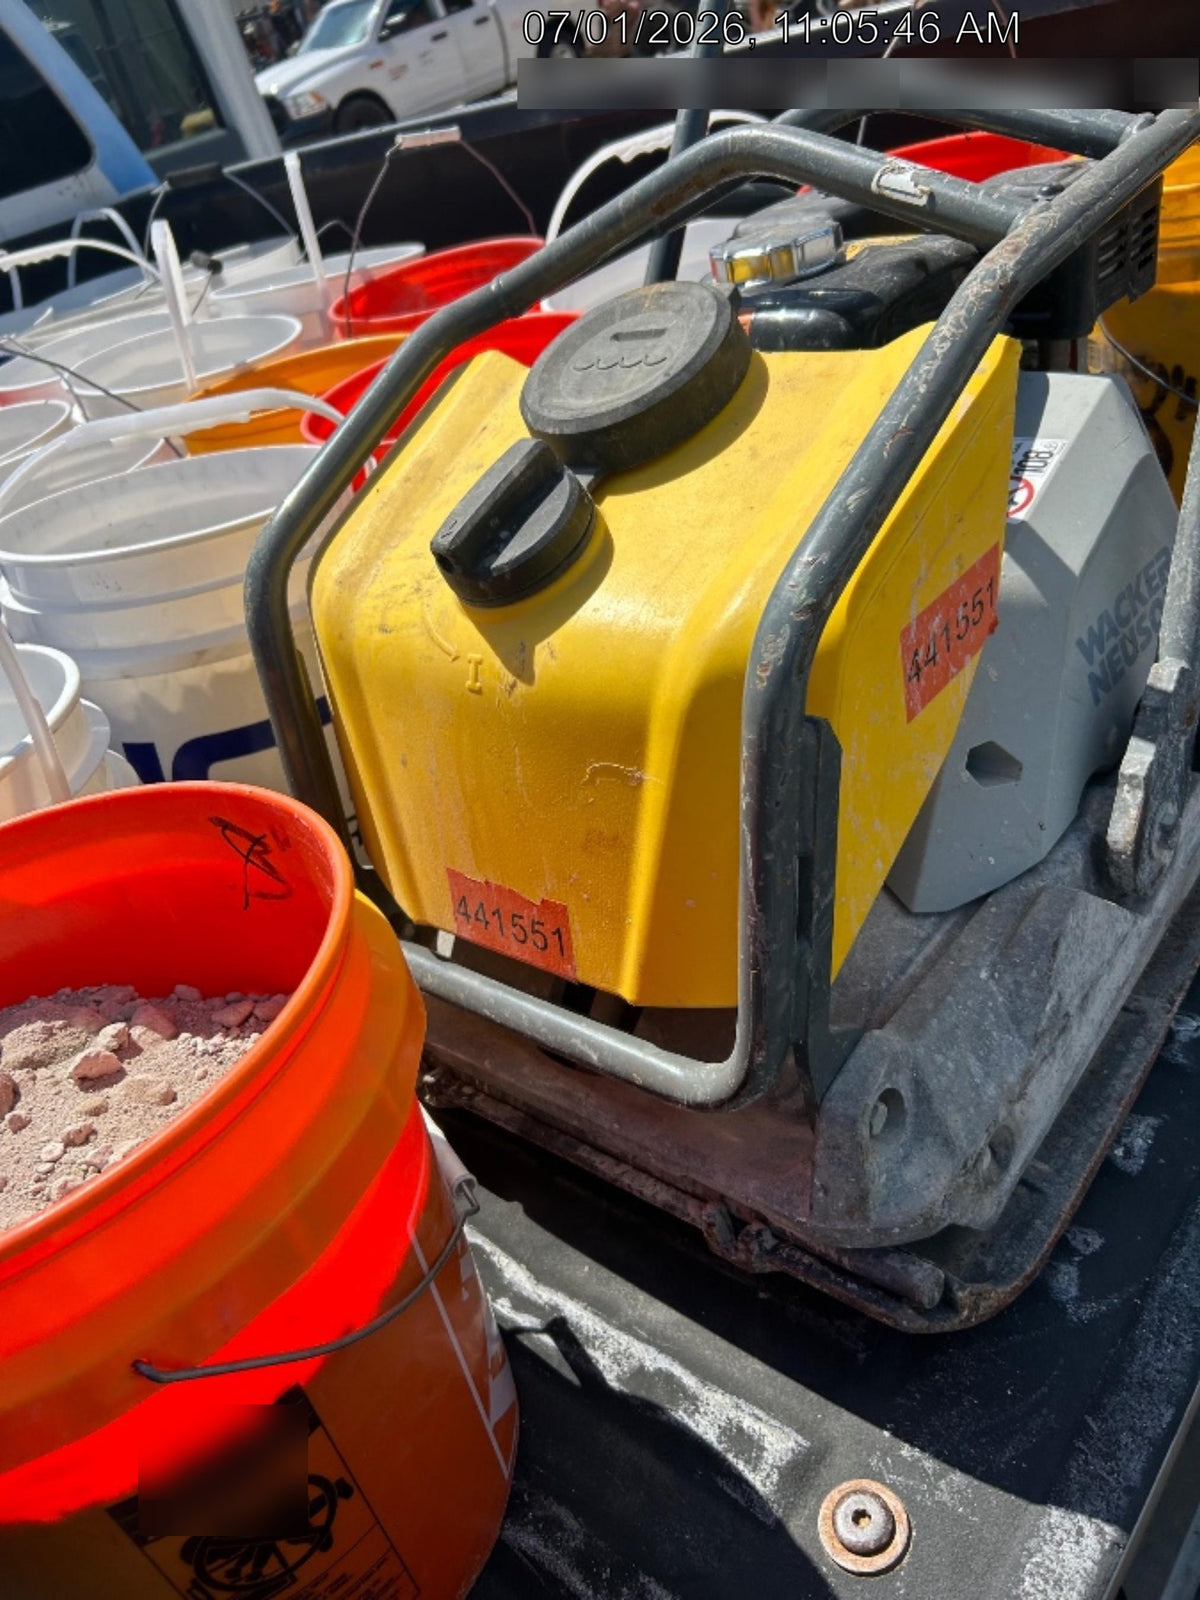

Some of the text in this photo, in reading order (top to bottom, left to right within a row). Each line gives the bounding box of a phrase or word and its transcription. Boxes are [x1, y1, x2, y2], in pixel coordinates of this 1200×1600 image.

[908, 576, 994, 683] 441551
[1075, 546, 1172, 666] WACKER
[1087, 597, 1163, 707] NEUSO
[456, 895, 565, 957] 441551
